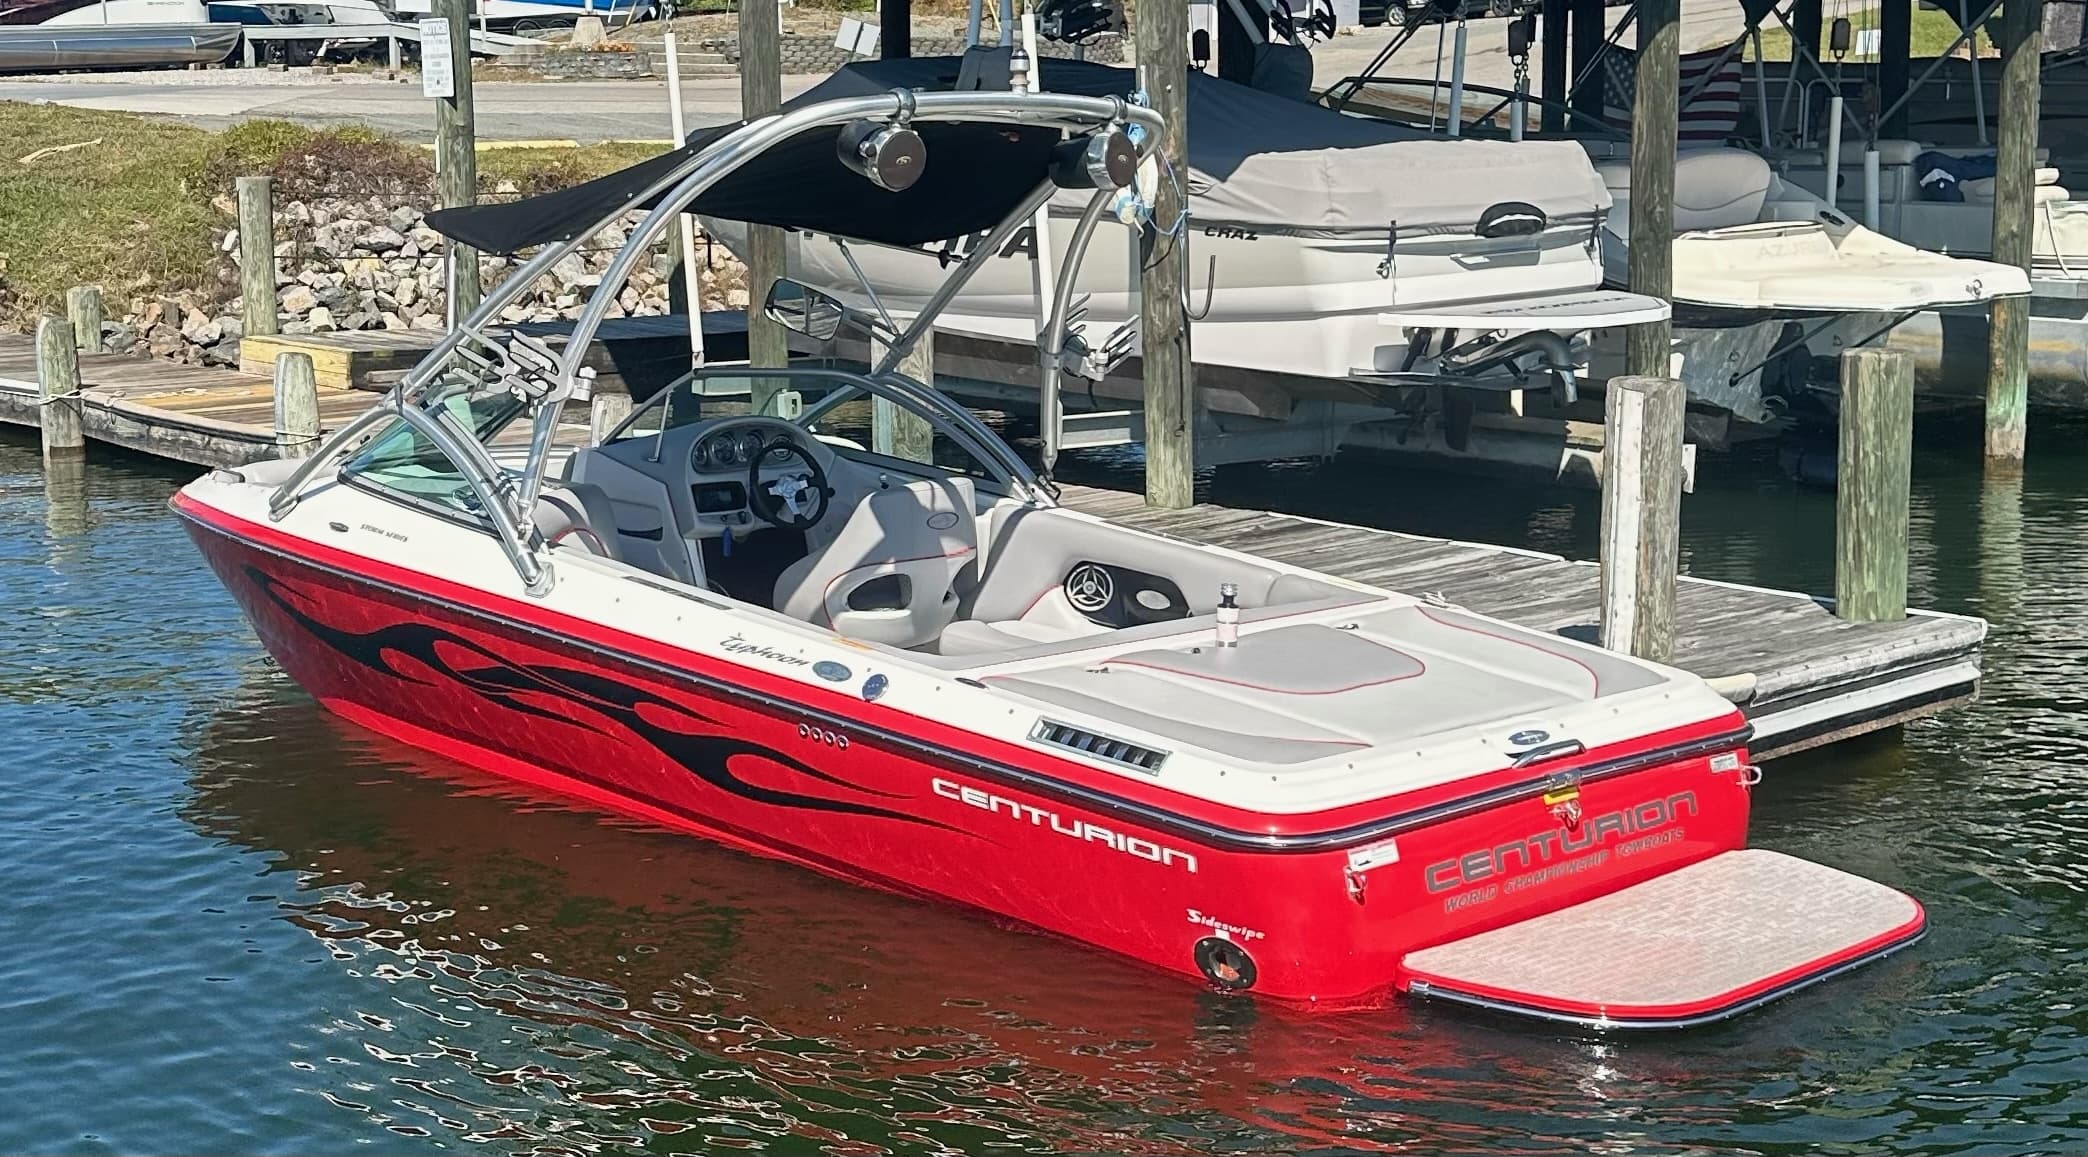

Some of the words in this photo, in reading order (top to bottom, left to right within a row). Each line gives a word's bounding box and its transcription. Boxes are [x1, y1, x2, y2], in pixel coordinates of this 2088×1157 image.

[1204, 226, 1259, 241] CRAZ
[932, 777, 1198, 874] CENTURION
[1425, 790, 1698, 895] CENTURION
[1444, 885, 1498, 913] WORLD
[1503, 849, 1610, 895] CHAMPIONSHIP
[1614, 828, 1685, 858] TOWBOATS
[1186, 908, 1266, 942] Sideswipe
